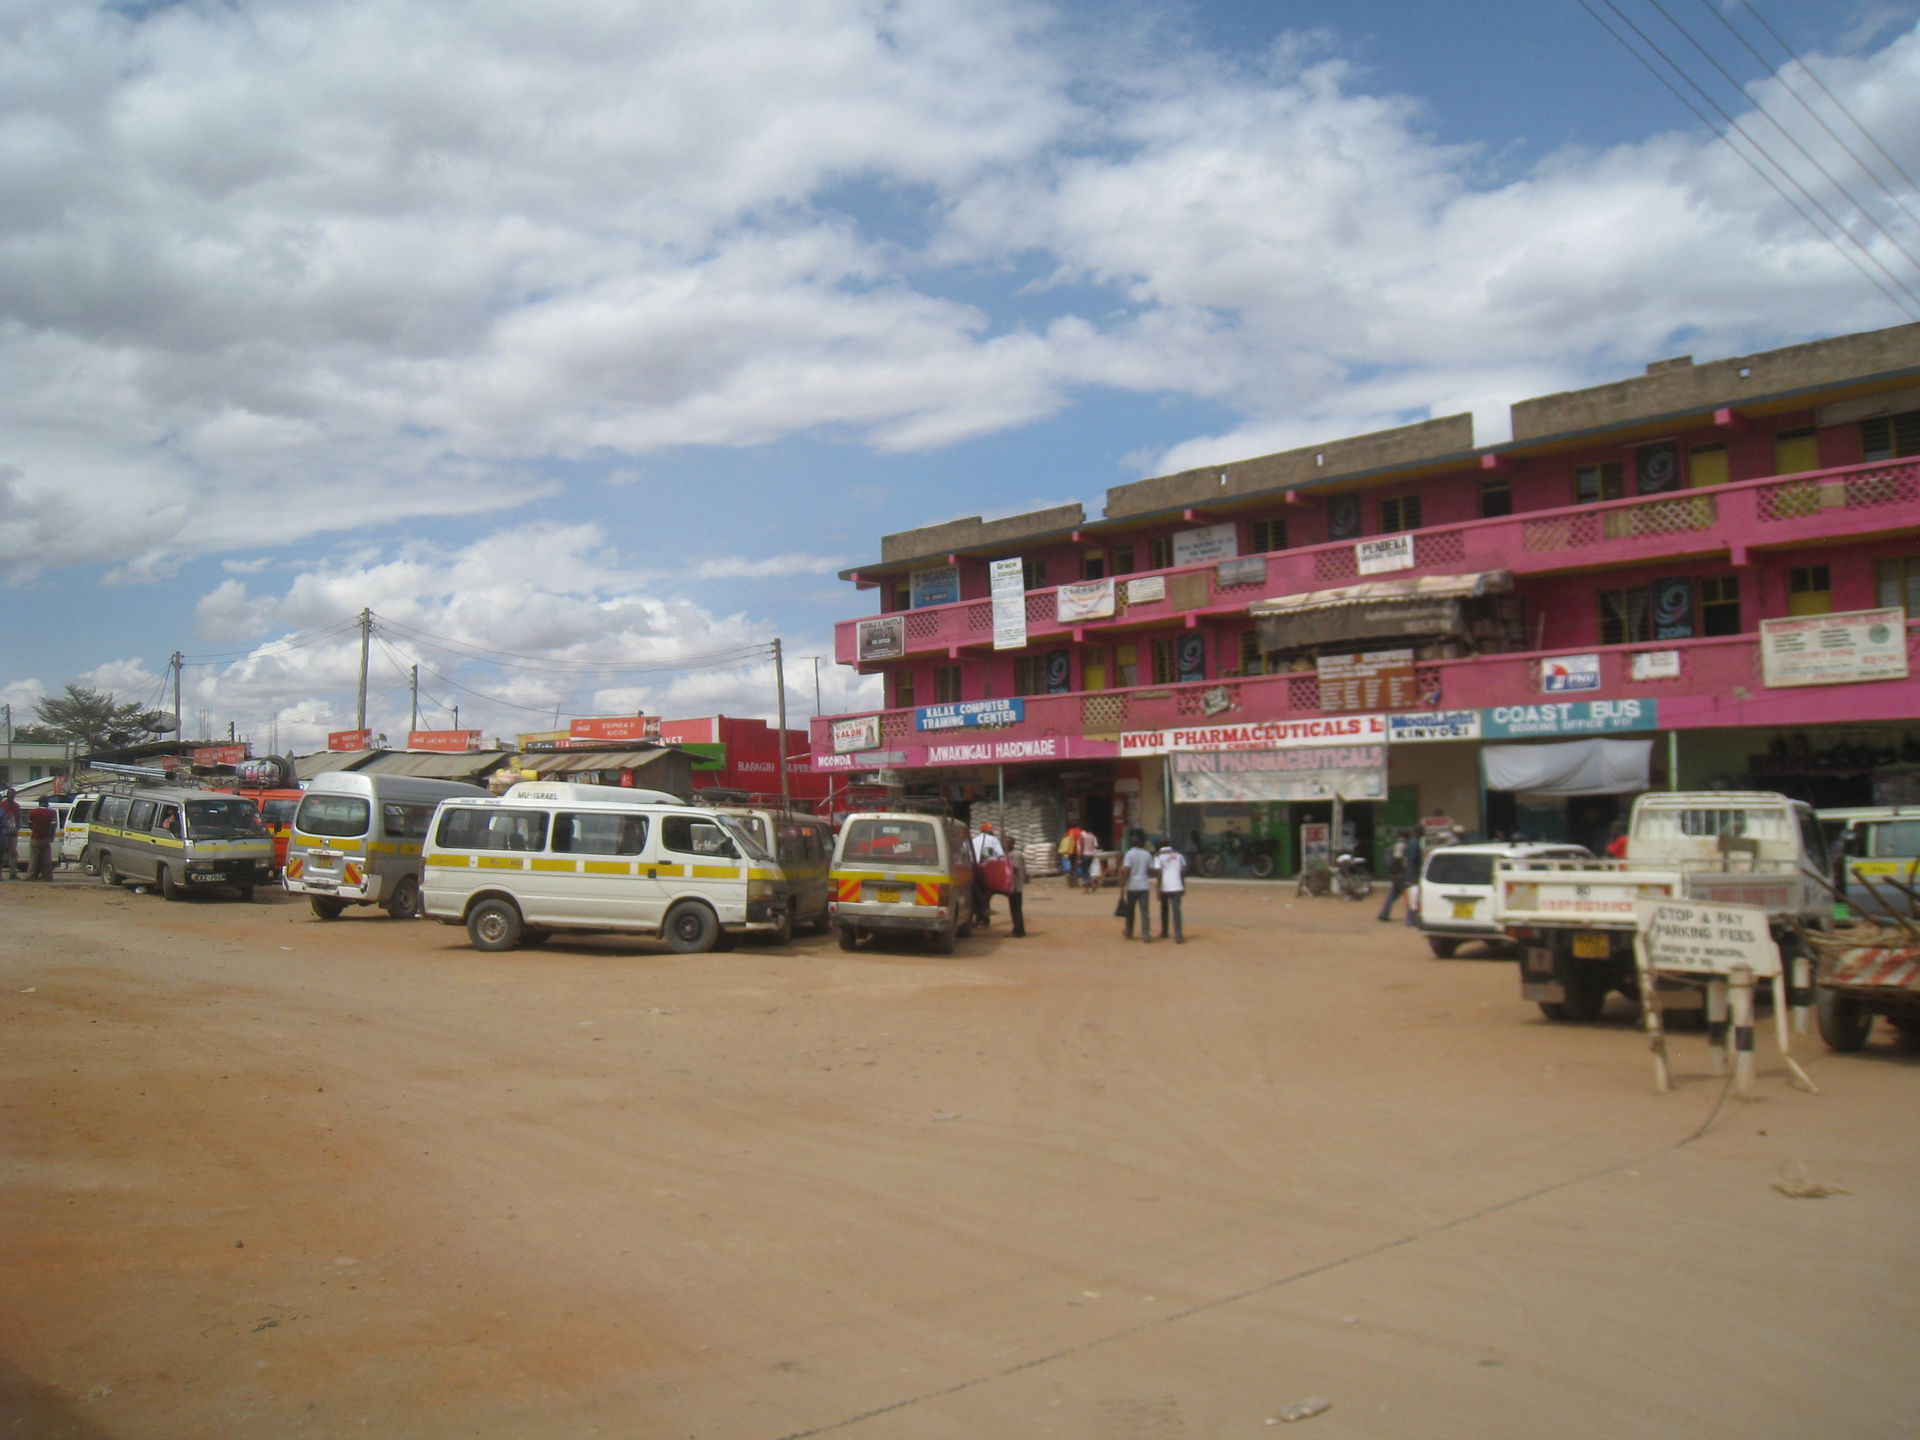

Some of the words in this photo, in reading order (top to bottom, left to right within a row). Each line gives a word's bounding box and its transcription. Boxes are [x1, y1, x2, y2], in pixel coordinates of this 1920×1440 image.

[960, 699, 1010, 714] COMPUTER
[1493, 703, 1573, 724] COAST
[1590, 700, 1641, 719] BUS
[922, 715, 964, 730] TRAINING
[977, 710, 1016, 724] CENTER
[1173, 719, 1361, 746] PHARMACEUTICALS
[996, 739, 1056, 758] HARDWARE
[1658, 906, 1694, 921] STOP
[1718, 911, 1744, 926] PAY
[1656, 924, 1713, 940] PARKING
[1719, 927, 1756, 944] FEES
